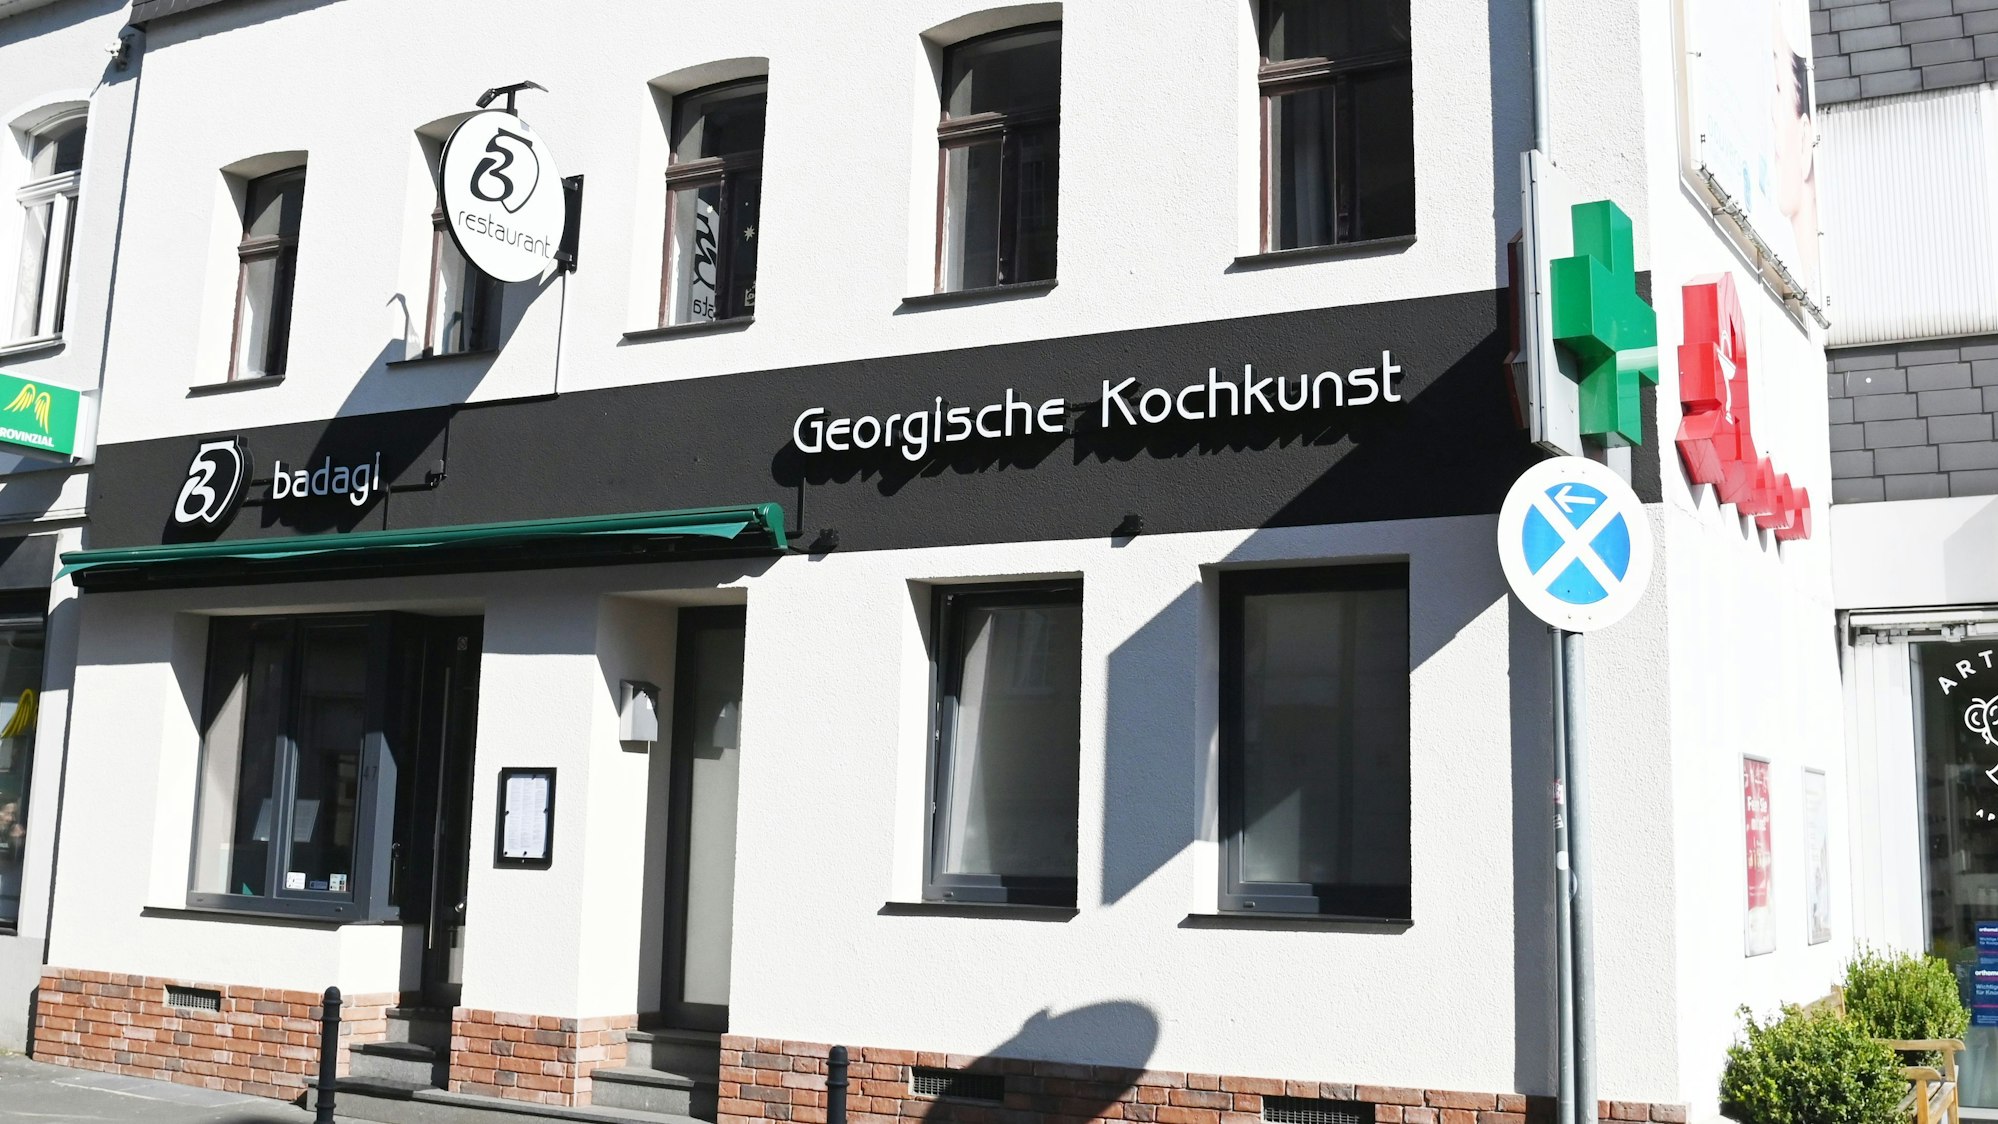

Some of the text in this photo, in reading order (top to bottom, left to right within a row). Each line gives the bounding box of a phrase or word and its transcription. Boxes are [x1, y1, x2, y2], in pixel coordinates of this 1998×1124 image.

[458, 210, 550, 258] restaurant
[793, 350, 1401, 461] Georgische Kochkunst
[272, 451, 381, 507] badagi
